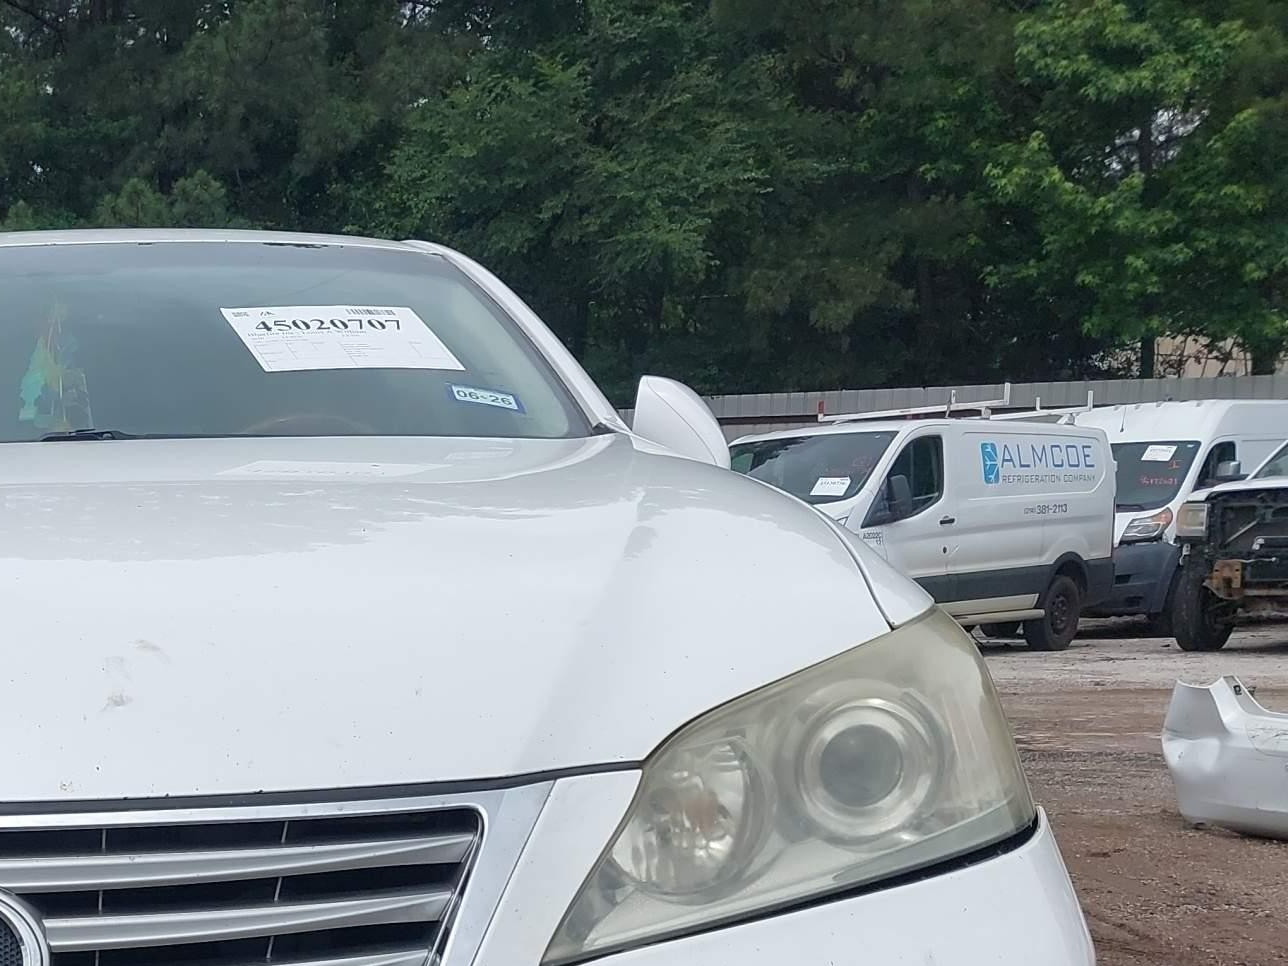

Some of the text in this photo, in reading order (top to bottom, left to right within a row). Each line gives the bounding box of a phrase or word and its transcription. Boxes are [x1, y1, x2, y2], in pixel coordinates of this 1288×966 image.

[255, 318, 401, 332] 45020707
[1001, 444, 1095, 469] ALMCOE
[1002, 473, 1095, 485] REFRIGERATION COMPANY
[1036, 503, 1068, 515] 381-2113
